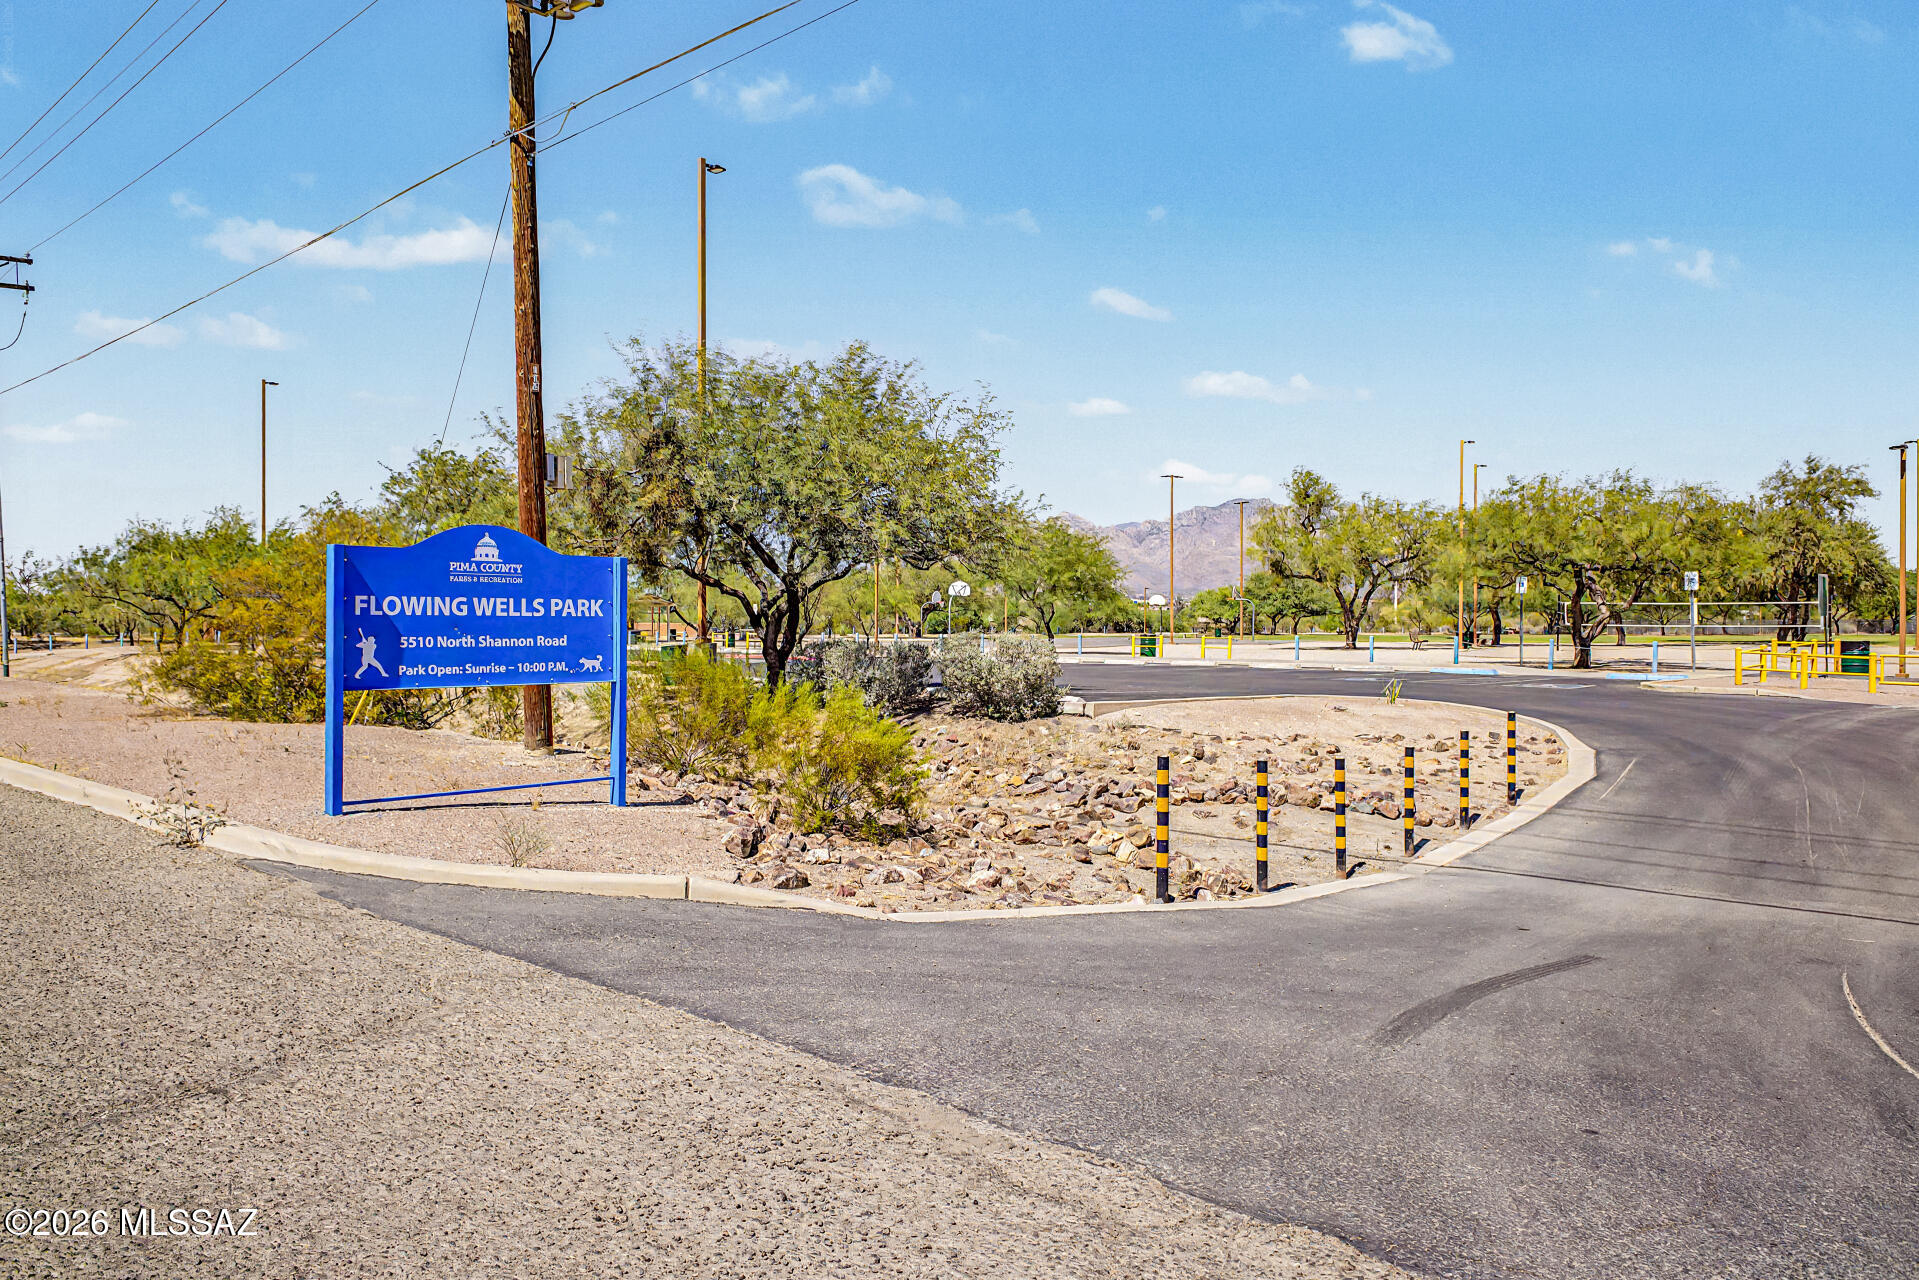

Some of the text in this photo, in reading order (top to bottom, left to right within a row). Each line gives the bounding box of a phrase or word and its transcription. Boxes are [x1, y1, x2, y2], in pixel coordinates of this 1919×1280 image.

[449, 562, 523, 573] PIMA COUNTY
[354, 595, 604, 617] FLOWING WELLS PARK
[400, 634, 568, 648] 5510 North Shannon Road
[398, 665, 426, 676] Park
[428, 664, 463, 677] Open:
[465, 663, 506, 674] Sunrise
[517, 662, 546, 673] 10:00
[548, 661, 569, 672] P.M.
